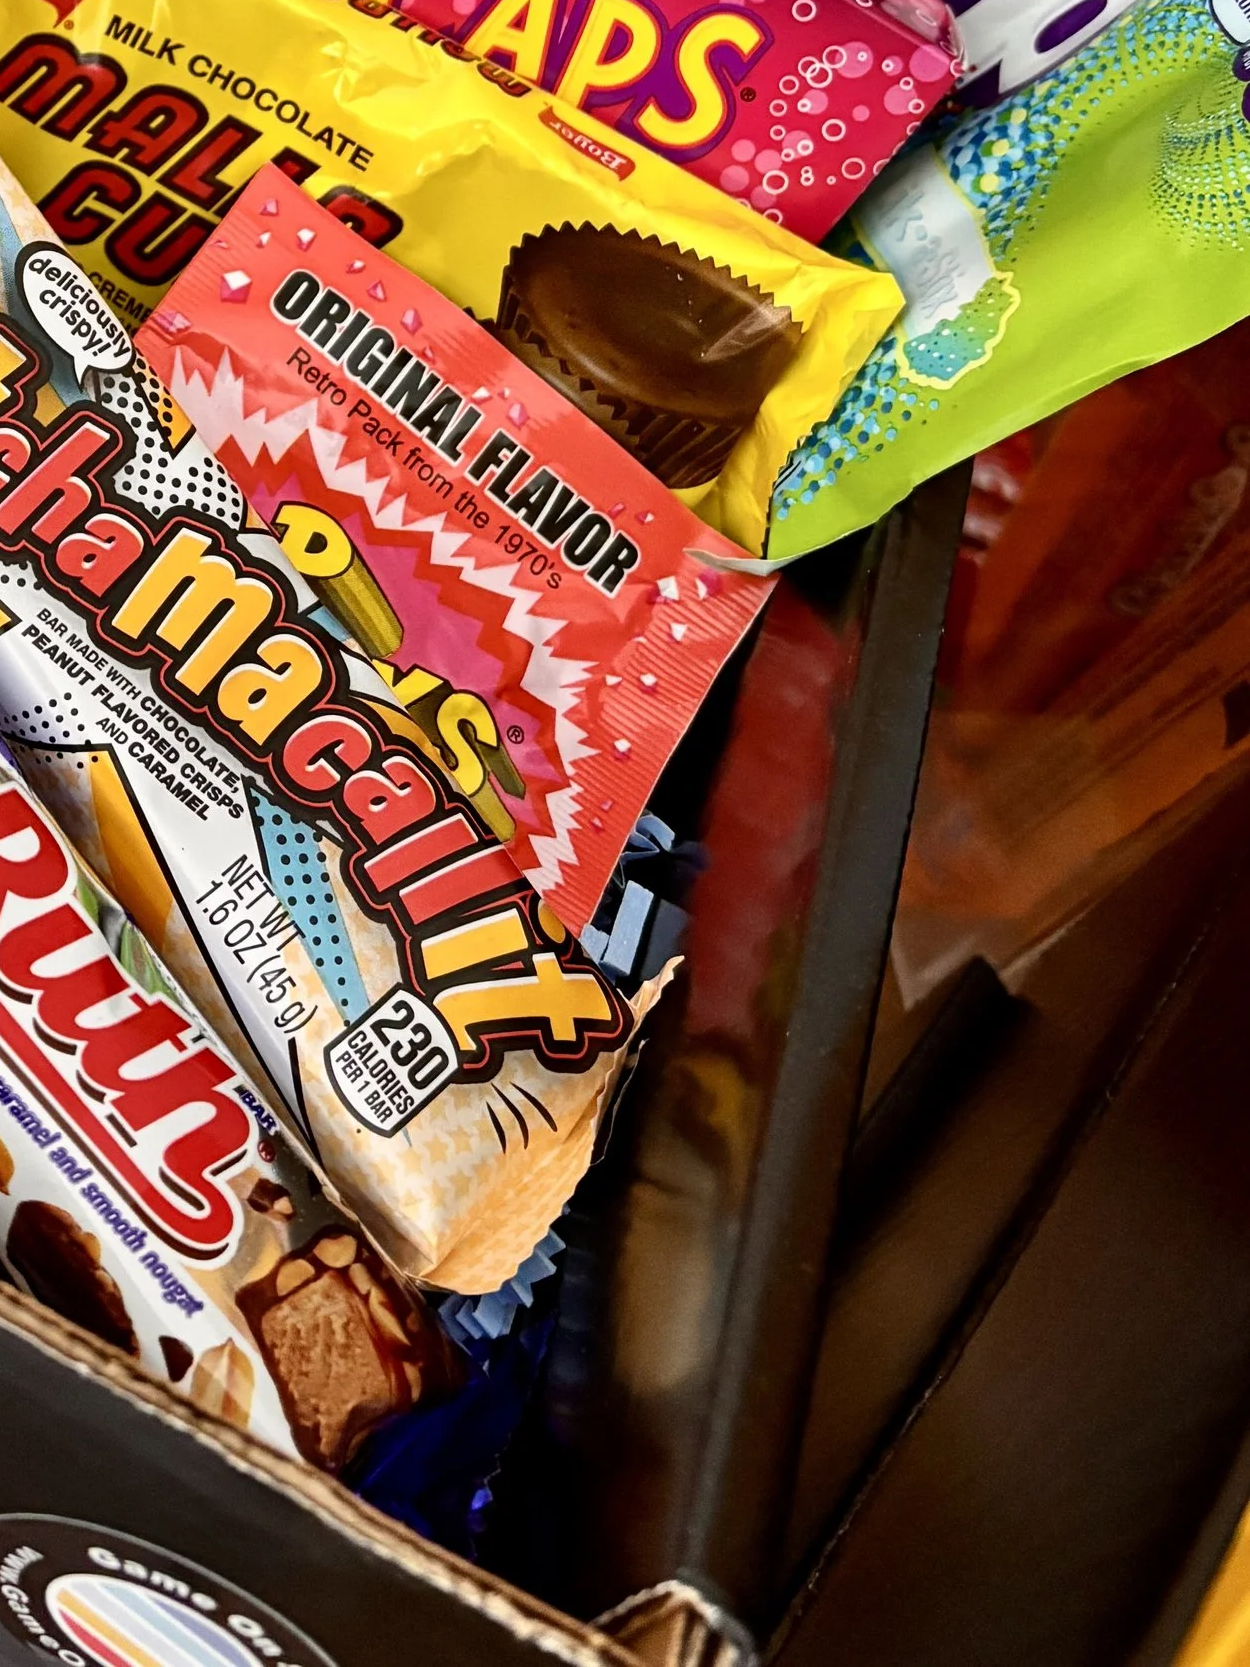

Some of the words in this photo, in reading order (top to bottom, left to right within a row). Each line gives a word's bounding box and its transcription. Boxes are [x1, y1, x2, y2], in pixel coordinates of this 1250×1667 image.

[105, 14, 185, 66] MILK
[187, 54, 375, 172] CHOCOLATE
[37, 159, 217, 287] CU
[28, 258, 131, 358] deliciously
[39, 289, 112, 357] crispy!
[272, 270, 485, 463] ORIGINAL
[468, 431, 639, 594] FLAVOR
[286, 346, 348, 407] Retro
[348, 398, 409, 457] Pack
[403, 446, 454, 500] from
[453, 490, 490, 530] the
[494, 524, 562, 590] 1970's
[21, 624, 95, 686] PEANUT
[91, 683, 180, 764] FLAVORED
[180, 762, 244, 819] CRISPS
[37, 608, 69, 638] BAR
[66, 633, 109, 672] MADE
[105, 666, 141, 700] WITH
[140, 696, 243, 794] CHOCOLATE,
[96, 717, 128, 745] AND
[128, 741, 210, 821] CARAMEL
[196, 880, 238, 925] 1.6
[224, 919, 267, 964] OZ
[247, 955, 296, 1004] (45
[274, 1001, 318, 1034] g)
[221, 854, 275, 909] NET
[260, 903, 306, 951] WT
[335, 1050, 364, 1086] PER
[356, 1082, 370, 1094] 1
[364, 1090, 393, 1124] BAR
[347, 1030, 415, 1115] CALORIES
[370, 999, 449, 1090] 230
[238, 1090, 278, 1135] BAR
[49, 1146, 94, 1185] and
[79, 1182, 149, 1254] smooth
[139, 1250, 204, 1319] nougat
[87, 1546, 219, 1611] Game
[227, 1614, 283, 1657] On
